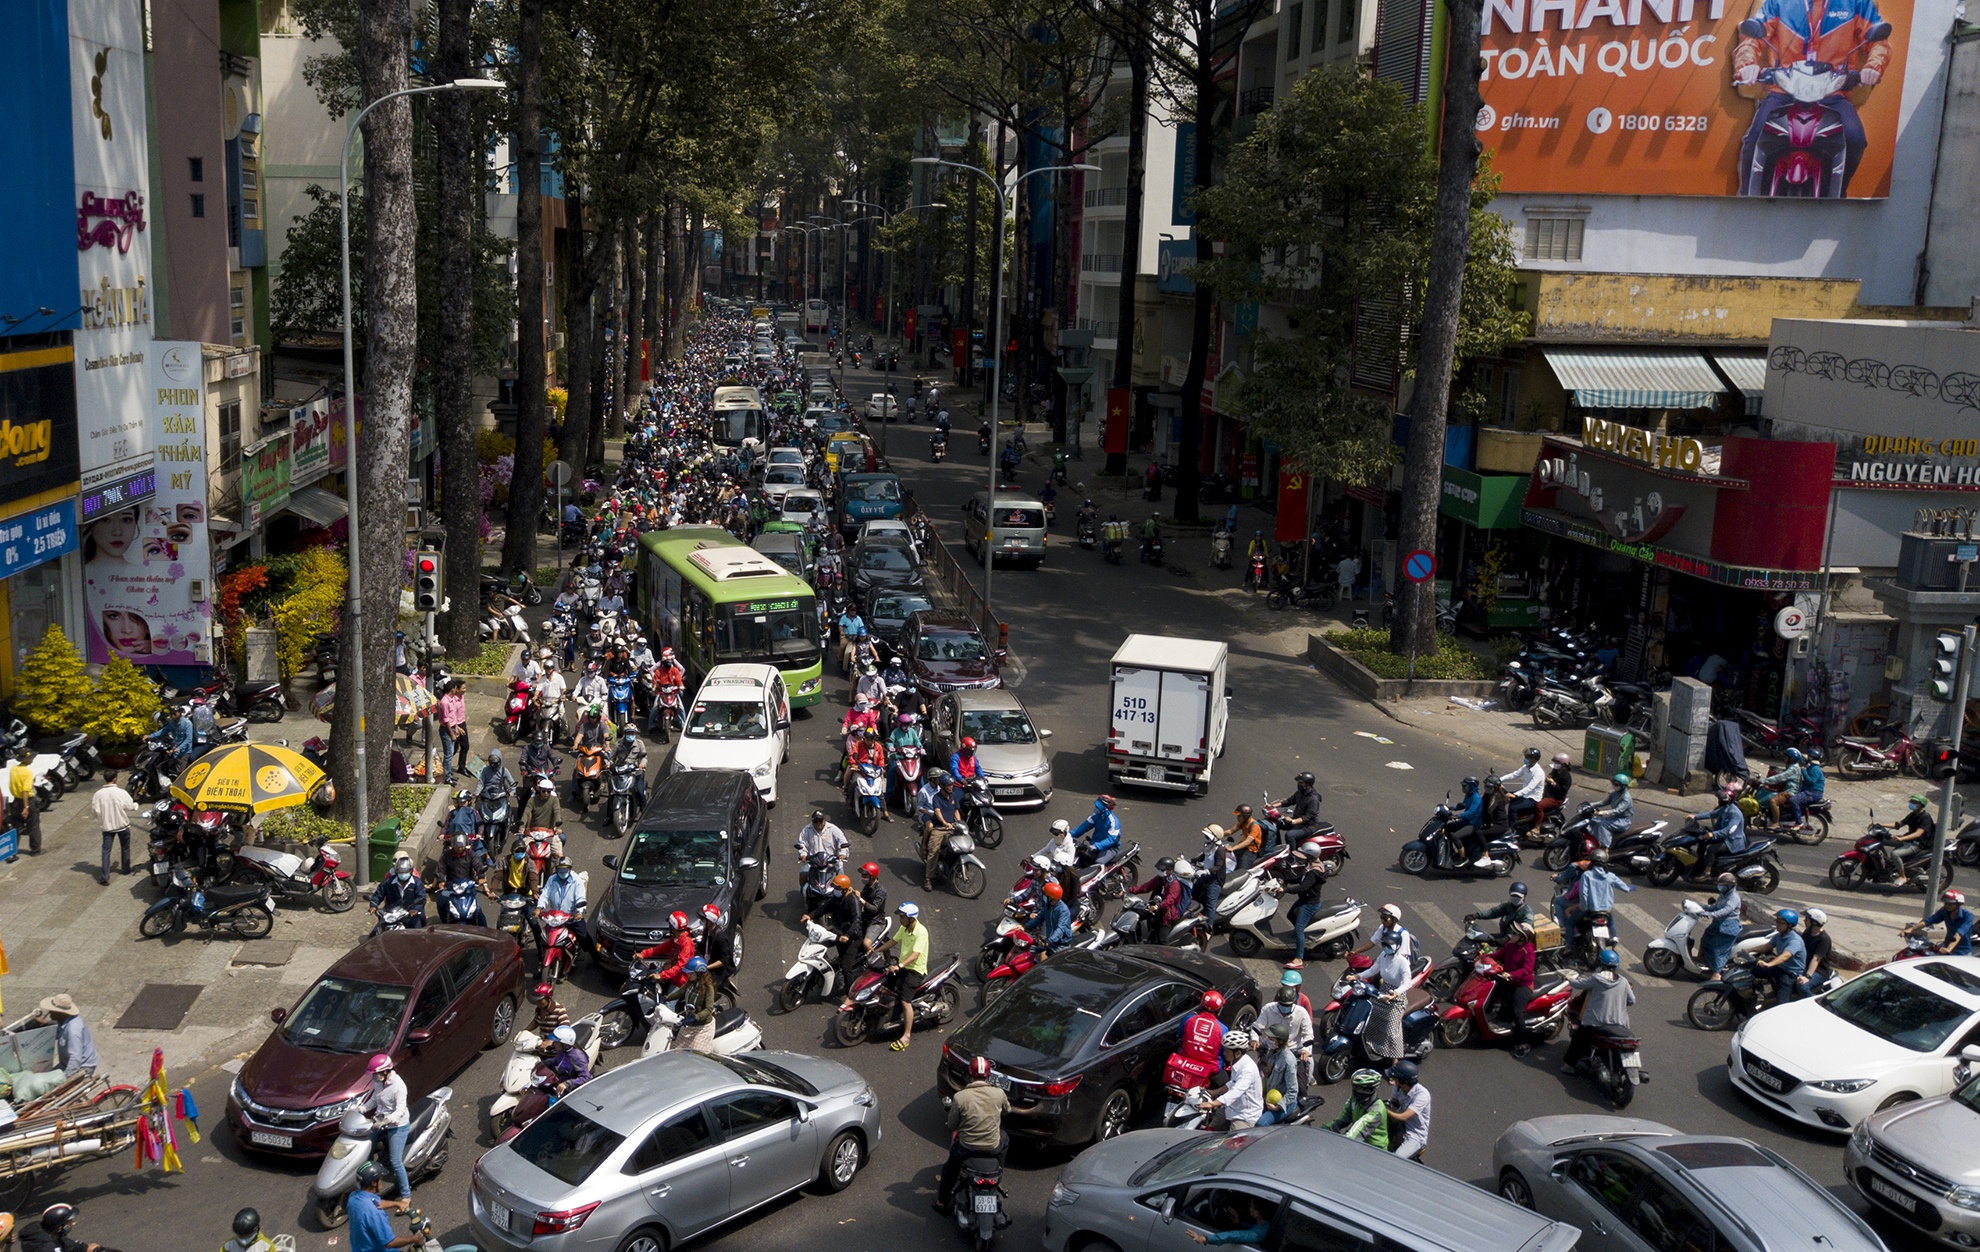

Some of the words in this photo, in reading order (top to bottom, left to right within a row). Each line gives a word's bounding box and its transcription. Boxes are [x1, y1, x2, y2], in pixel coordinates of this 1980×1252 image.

[1479, 38, 1586, 81] TOÀN
[1597, 25, 1718, 77] QUỐC
[1501, 112, 1560, 132] ghn.vn
[1618, 114, 1661, 131] 1800
[1664, 114, 1708, 132] 6328
[1659, 434, 1704, 472] HO
[1850, 459, 1951, 484] NGUYÊN
[5, 544, 19, 565] 0%
[1123, 696, 1147, 709] 51D
[225, 787, 246, 798] THOẠI
[1193, 1034, 1208, 1044] Now
